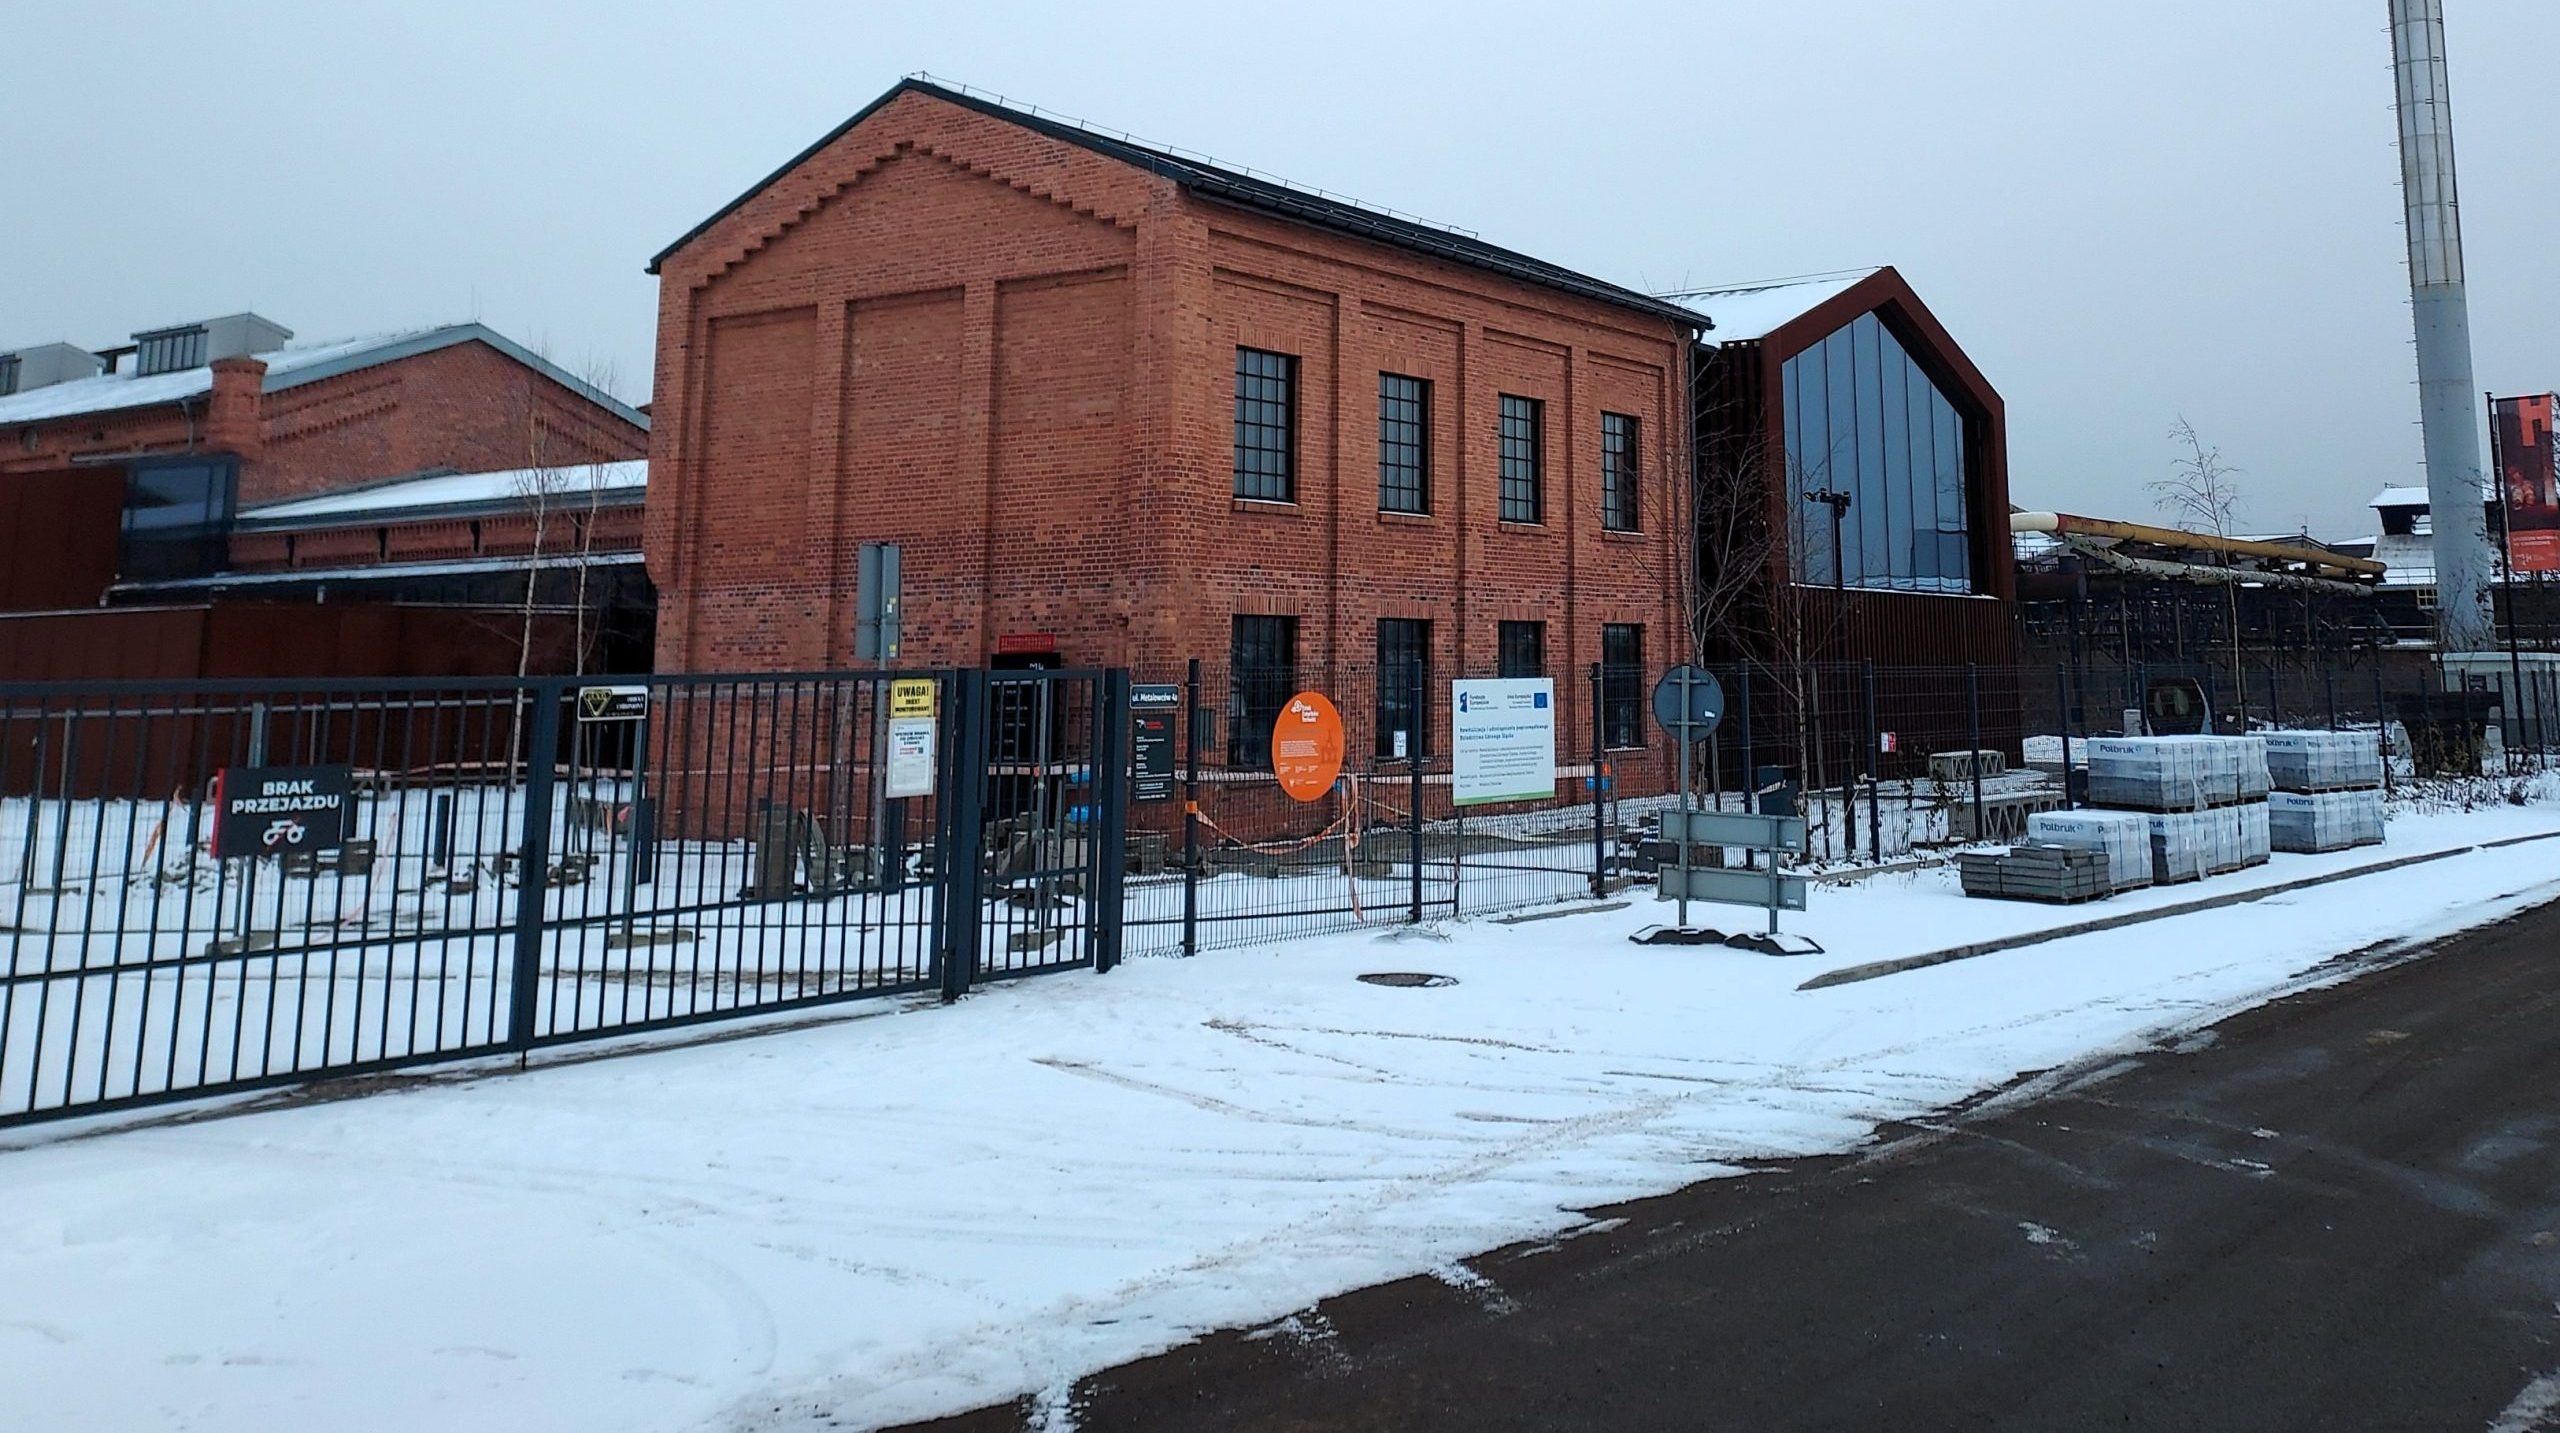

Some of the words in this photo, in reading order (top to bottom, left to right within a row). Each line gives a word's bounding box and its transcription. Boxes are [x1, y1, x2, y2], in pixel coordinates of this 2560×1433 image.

[897, 686, 929, 697] UWAGA!
[2100, 744, 2135, 754] Polbruk
[262, 780, 315, 797] BRAK
[231, 794, 340, 815] PRZEJAZDU
[2286, 798, 2314, 806] Polbru
[2040, 821, 2076, 833] Polbruk
